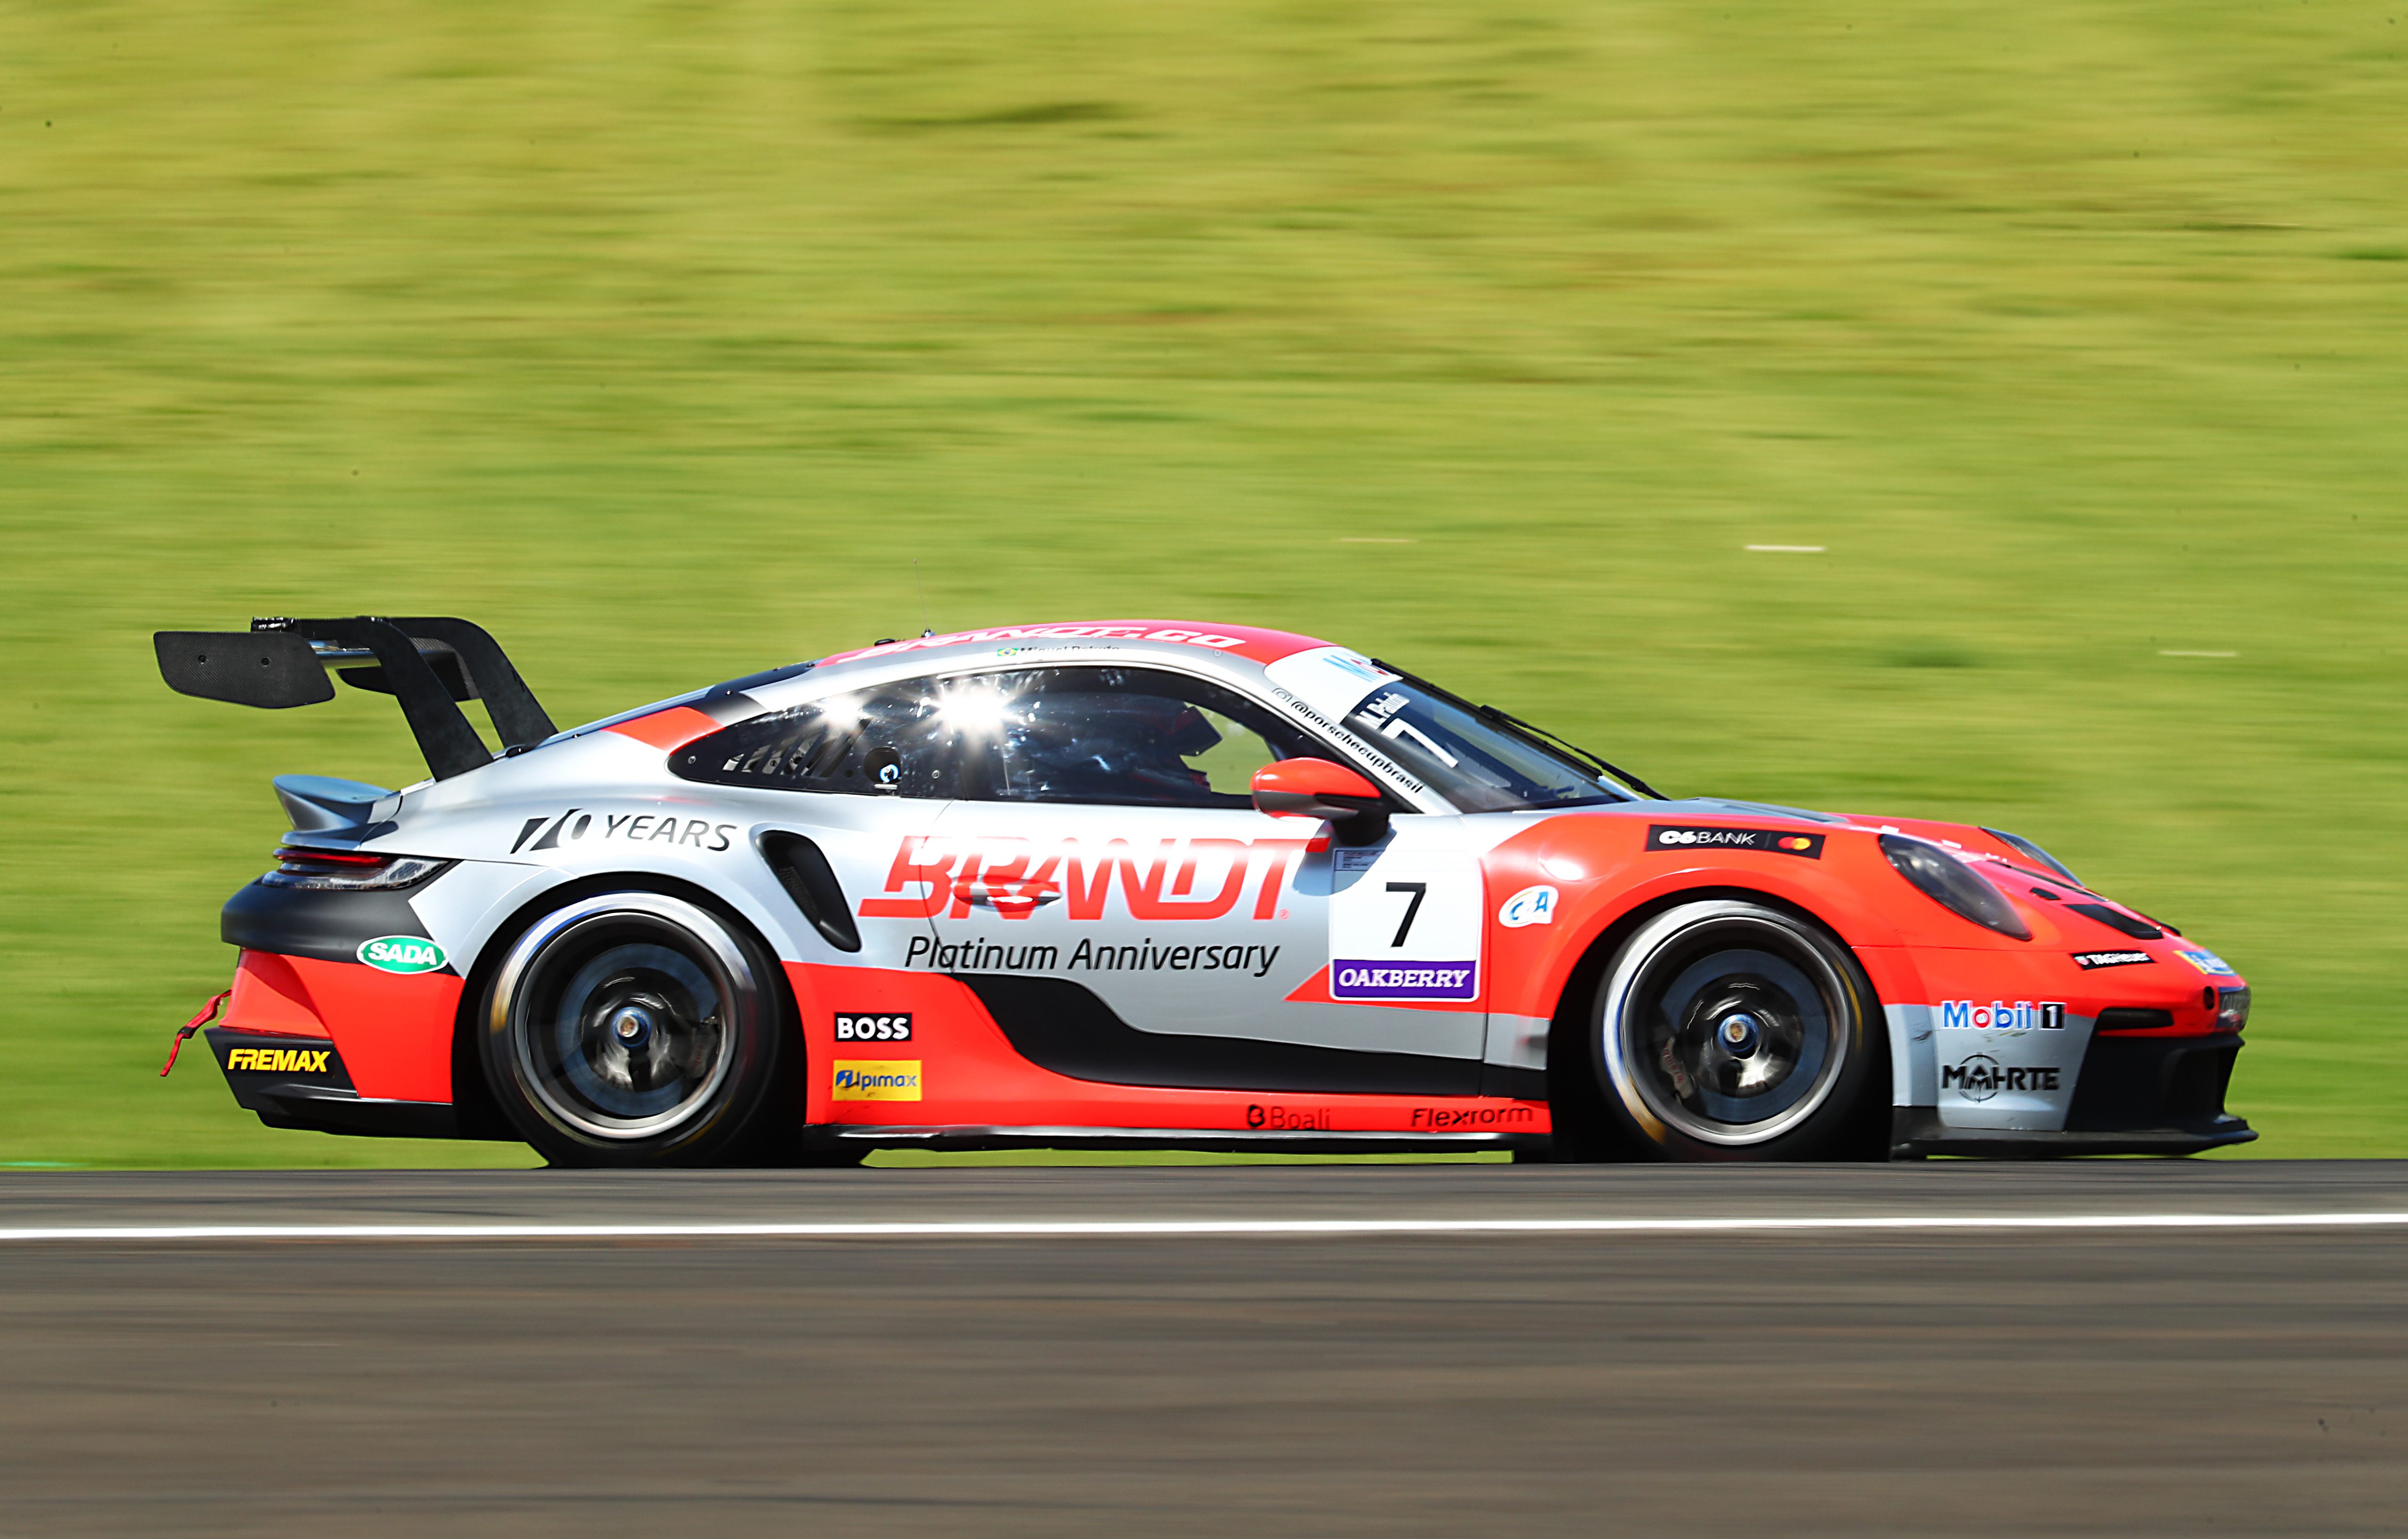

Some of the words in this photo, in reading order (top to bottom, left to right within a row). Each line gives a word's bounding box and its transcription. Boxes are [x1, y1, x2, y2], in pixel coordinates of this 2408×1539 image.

[1291, 700, 1426, 793] @porschecupbrasil
[1381, 718, 1458, 768] 7
[605, 815, 738, 851] YEARS
[857, 836, 1330, 920] BRANDT
[1386, 882, 1426, 948] 7
[368, 943, 437, 965] SADA
[904, 936, 1058, 971] Platinum
[1069, 937, 1282, 977] Anniversary
[1339, 968, 1471, 988] OAKBERRY
[837, 1016, 909, 1039] BOSS
[1941, 1001, 2032, 1029] Mobil
[228, 1049, 331, 1072] FREMAX
[1271, 1106, 1330, 1130] Boali
